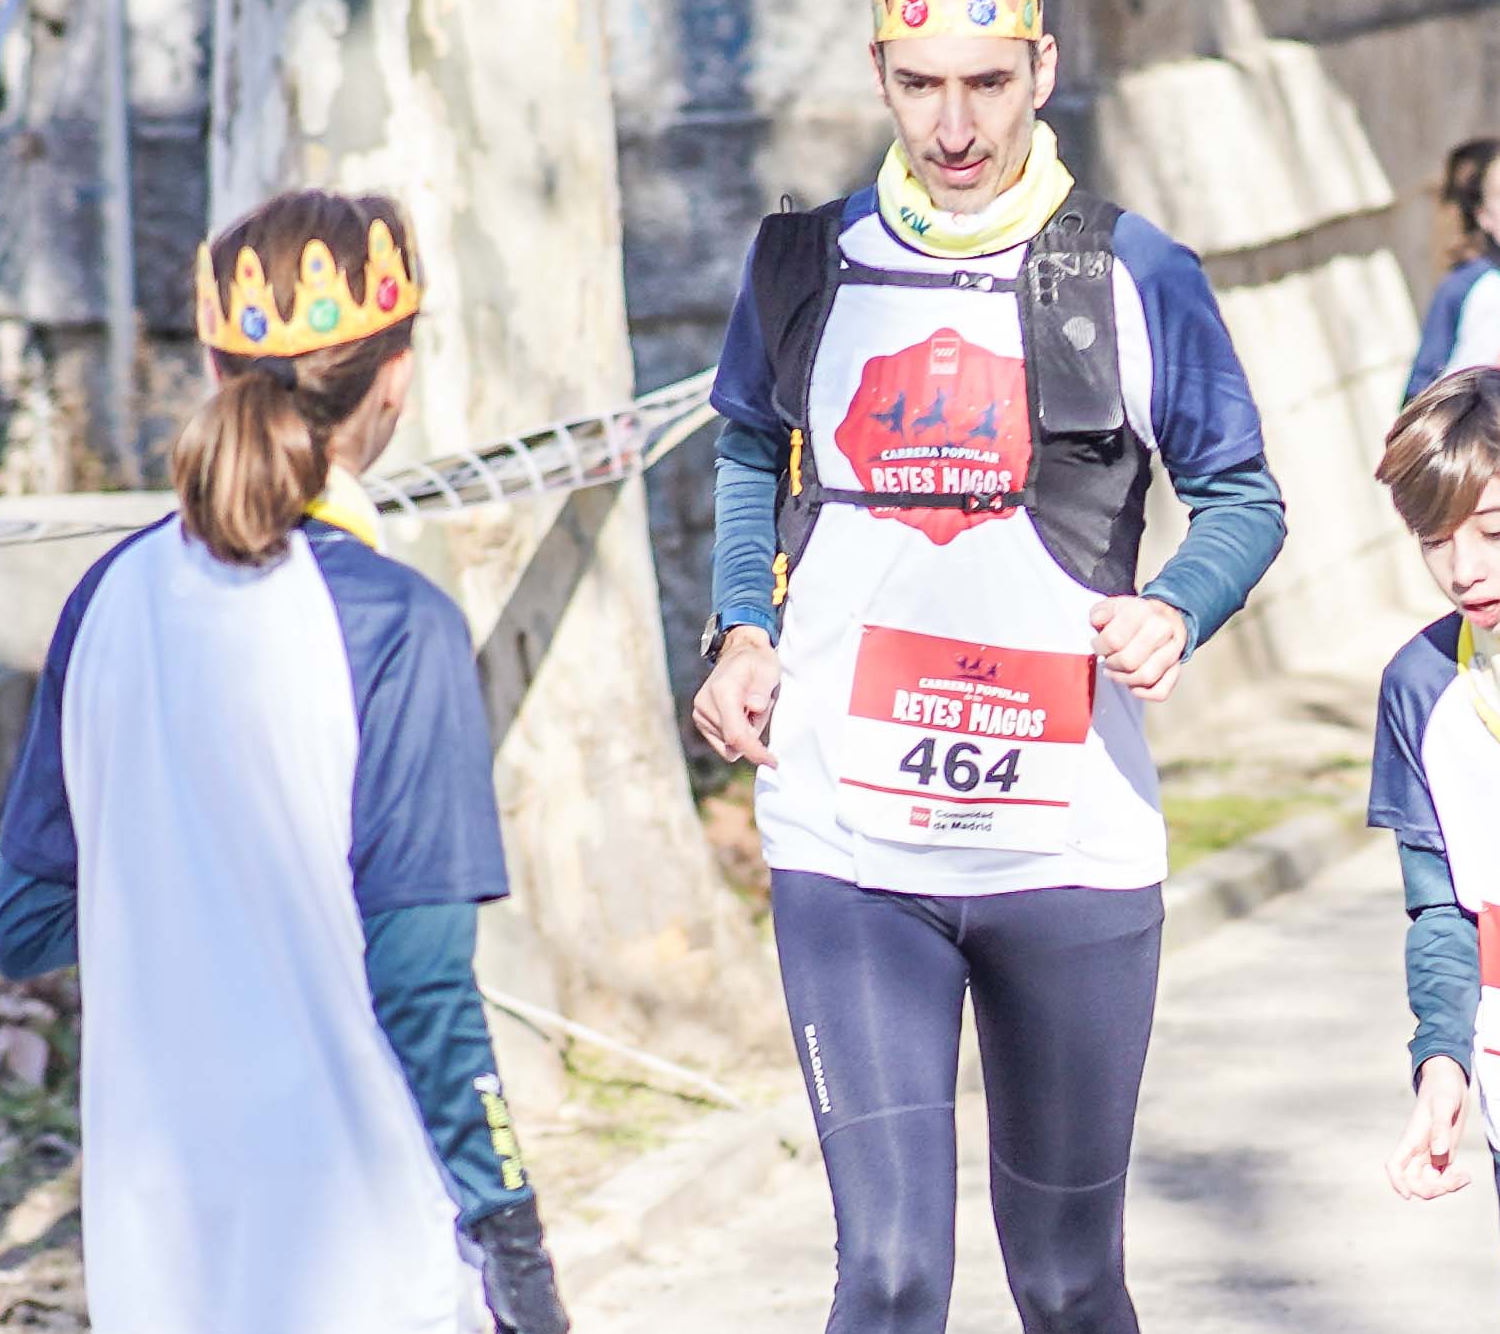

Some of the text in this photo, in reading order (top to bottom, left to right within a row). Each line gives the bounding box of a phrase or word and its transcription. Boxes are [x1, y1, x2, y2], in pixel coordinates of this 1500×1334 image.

[941, 447, 1000, 464] POPULAR
[871, 466, 1013, 494] REYES MAGOS
[892, 688, 1047, 738] REYES MAGOS
[899, 737, 1022, 793] 464
